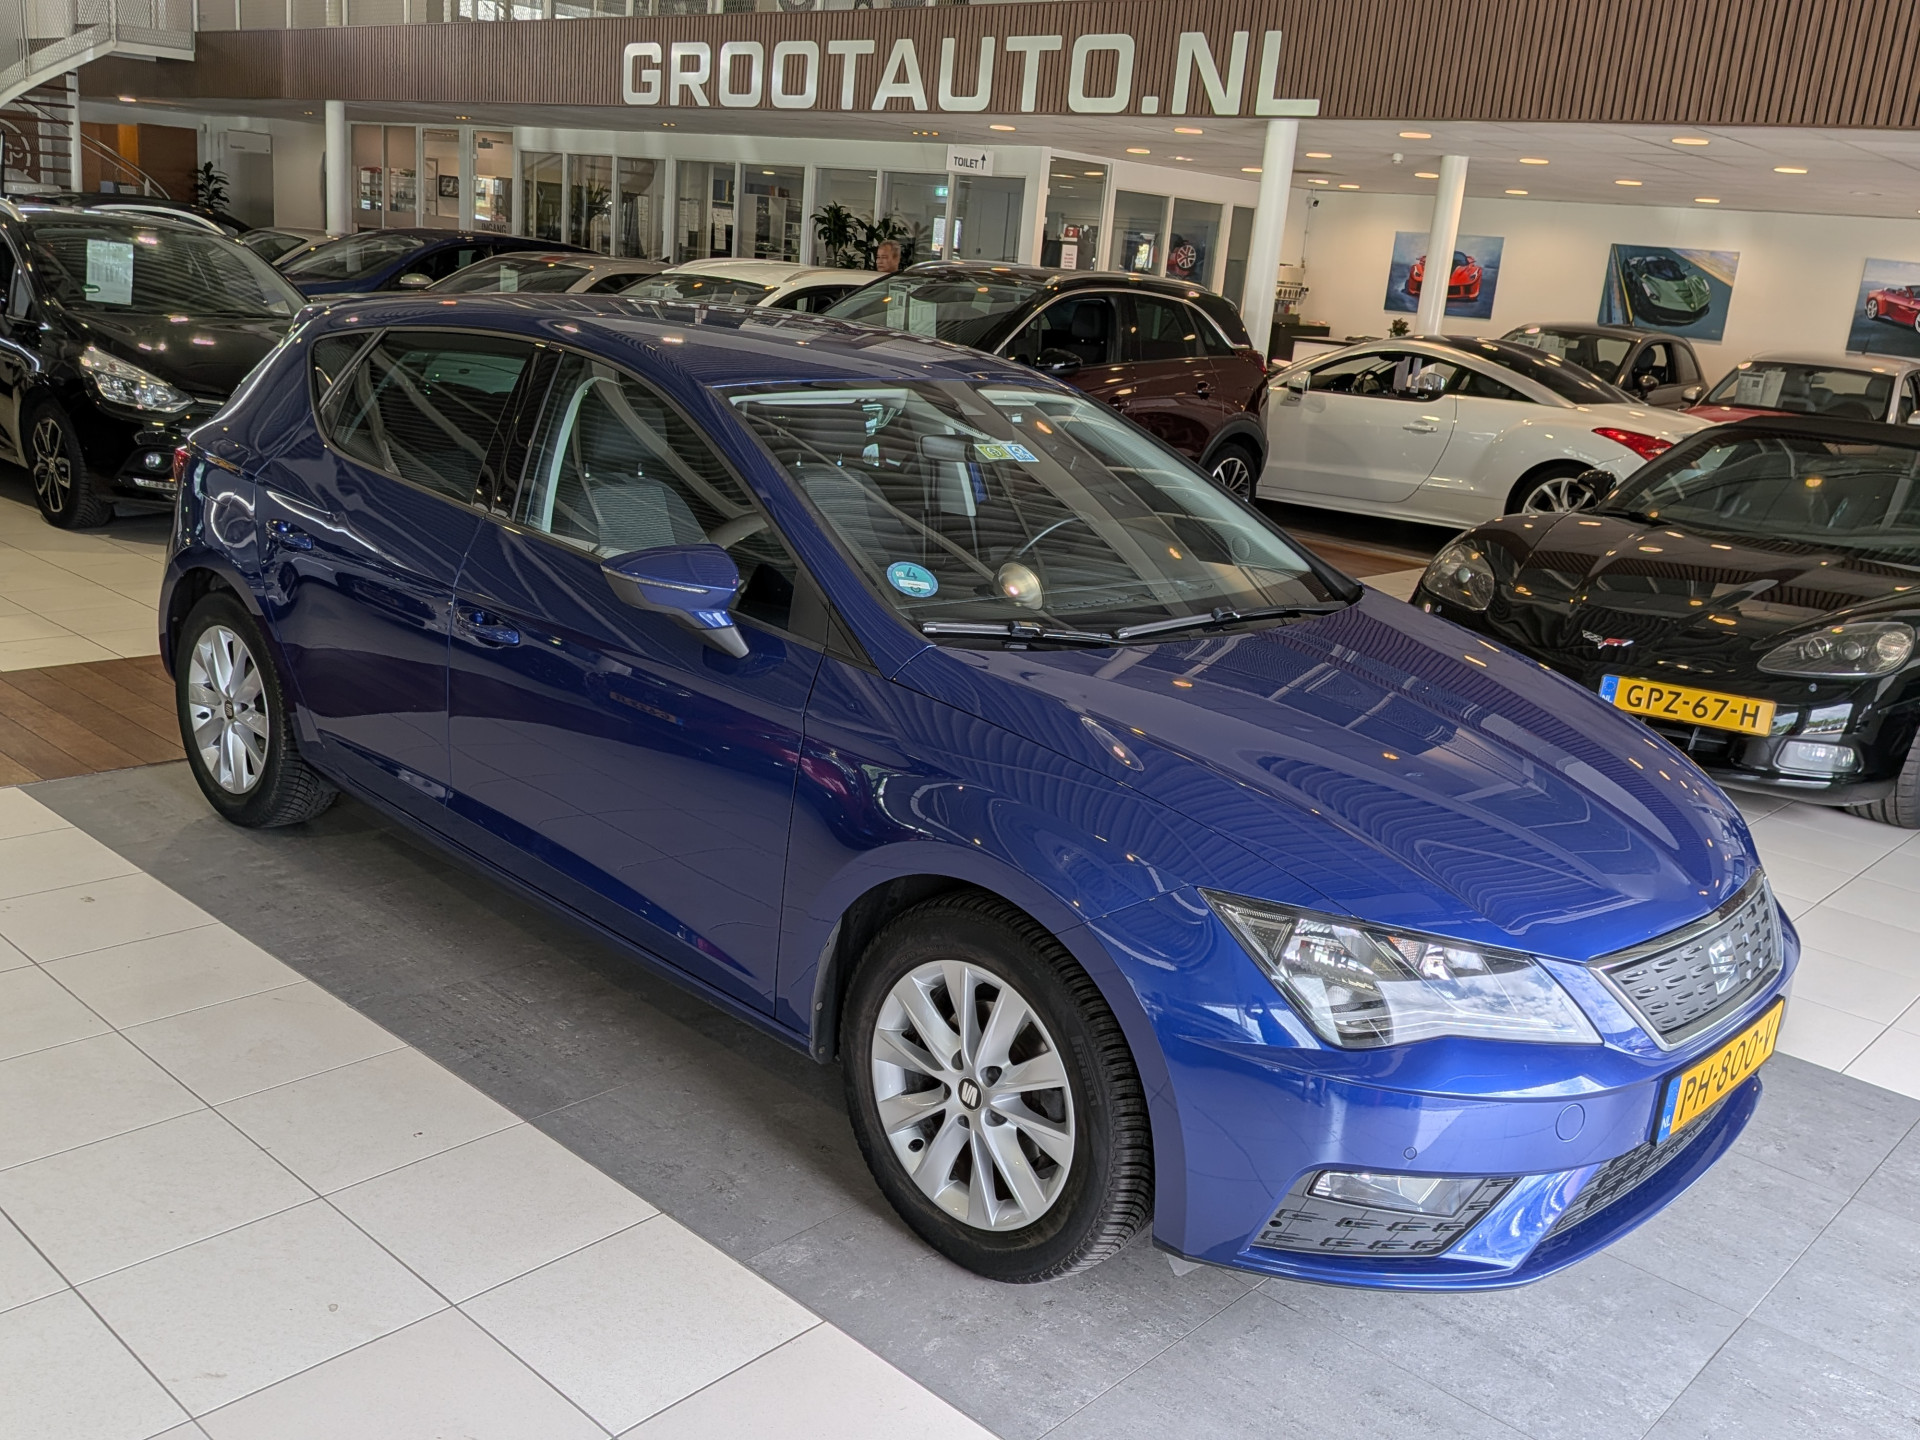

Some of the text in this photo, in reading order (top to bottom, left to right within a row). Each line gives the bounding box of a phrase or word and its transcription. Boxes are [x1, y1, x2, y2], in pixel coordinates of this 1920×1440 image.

[622, 30, 1319, 117] GROOTAUTO.NL
[953, 156, 979, 169] TOILET
[1626, 684, 1761, 728] GPZ-67-H
[1678, 1013, 1778, 1122] PH-800-V
[1660, 1113, 1671, 1131] NL
